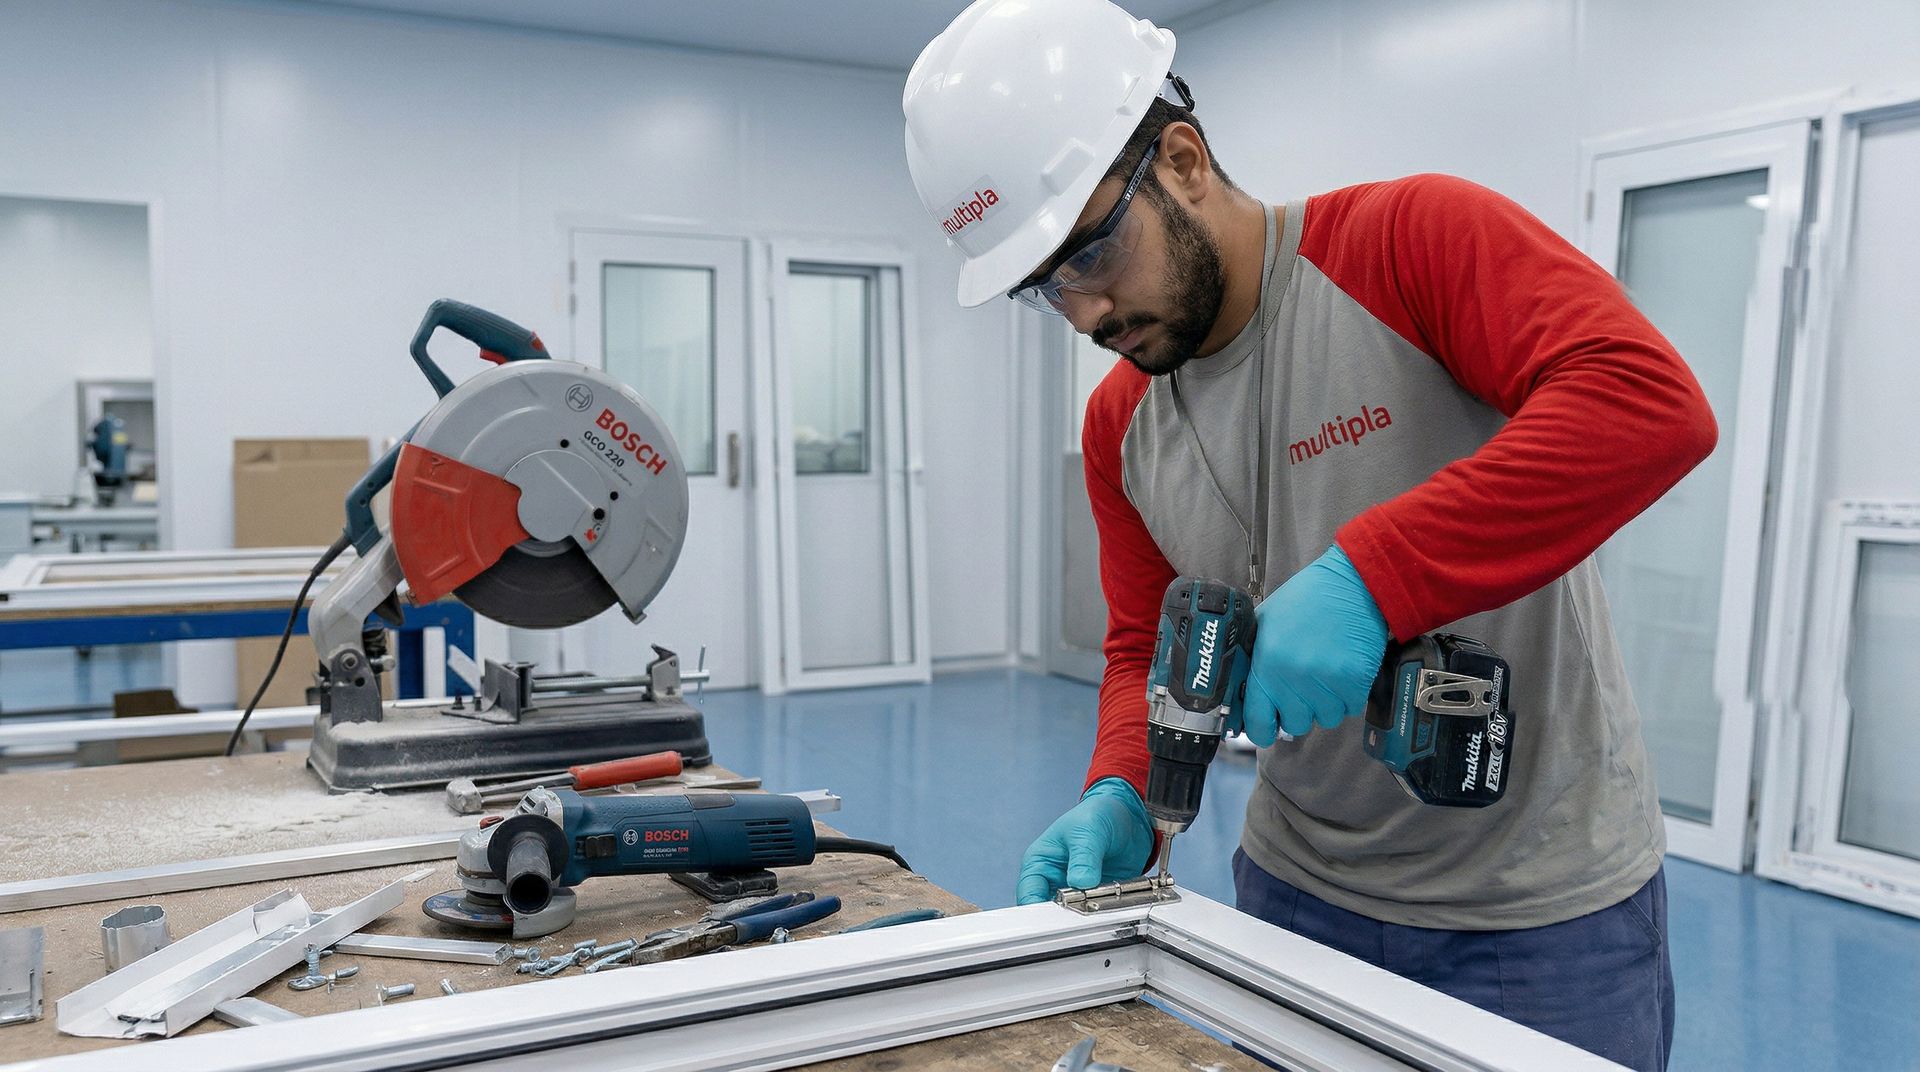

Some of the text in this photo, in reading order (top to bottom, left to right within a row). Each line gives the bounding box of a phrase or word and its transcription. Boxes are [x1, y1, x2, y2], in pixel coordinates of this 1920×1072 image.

[943, 189, 999, 235] multipla
[584, 430, 606, 451] GCO
[604, 449, 625, 467] 220
[595, 408, 668, 476] BOSCH
[1289, 404, 1392, 465] multipla
[644, 829, 689, 842] BOSCH
